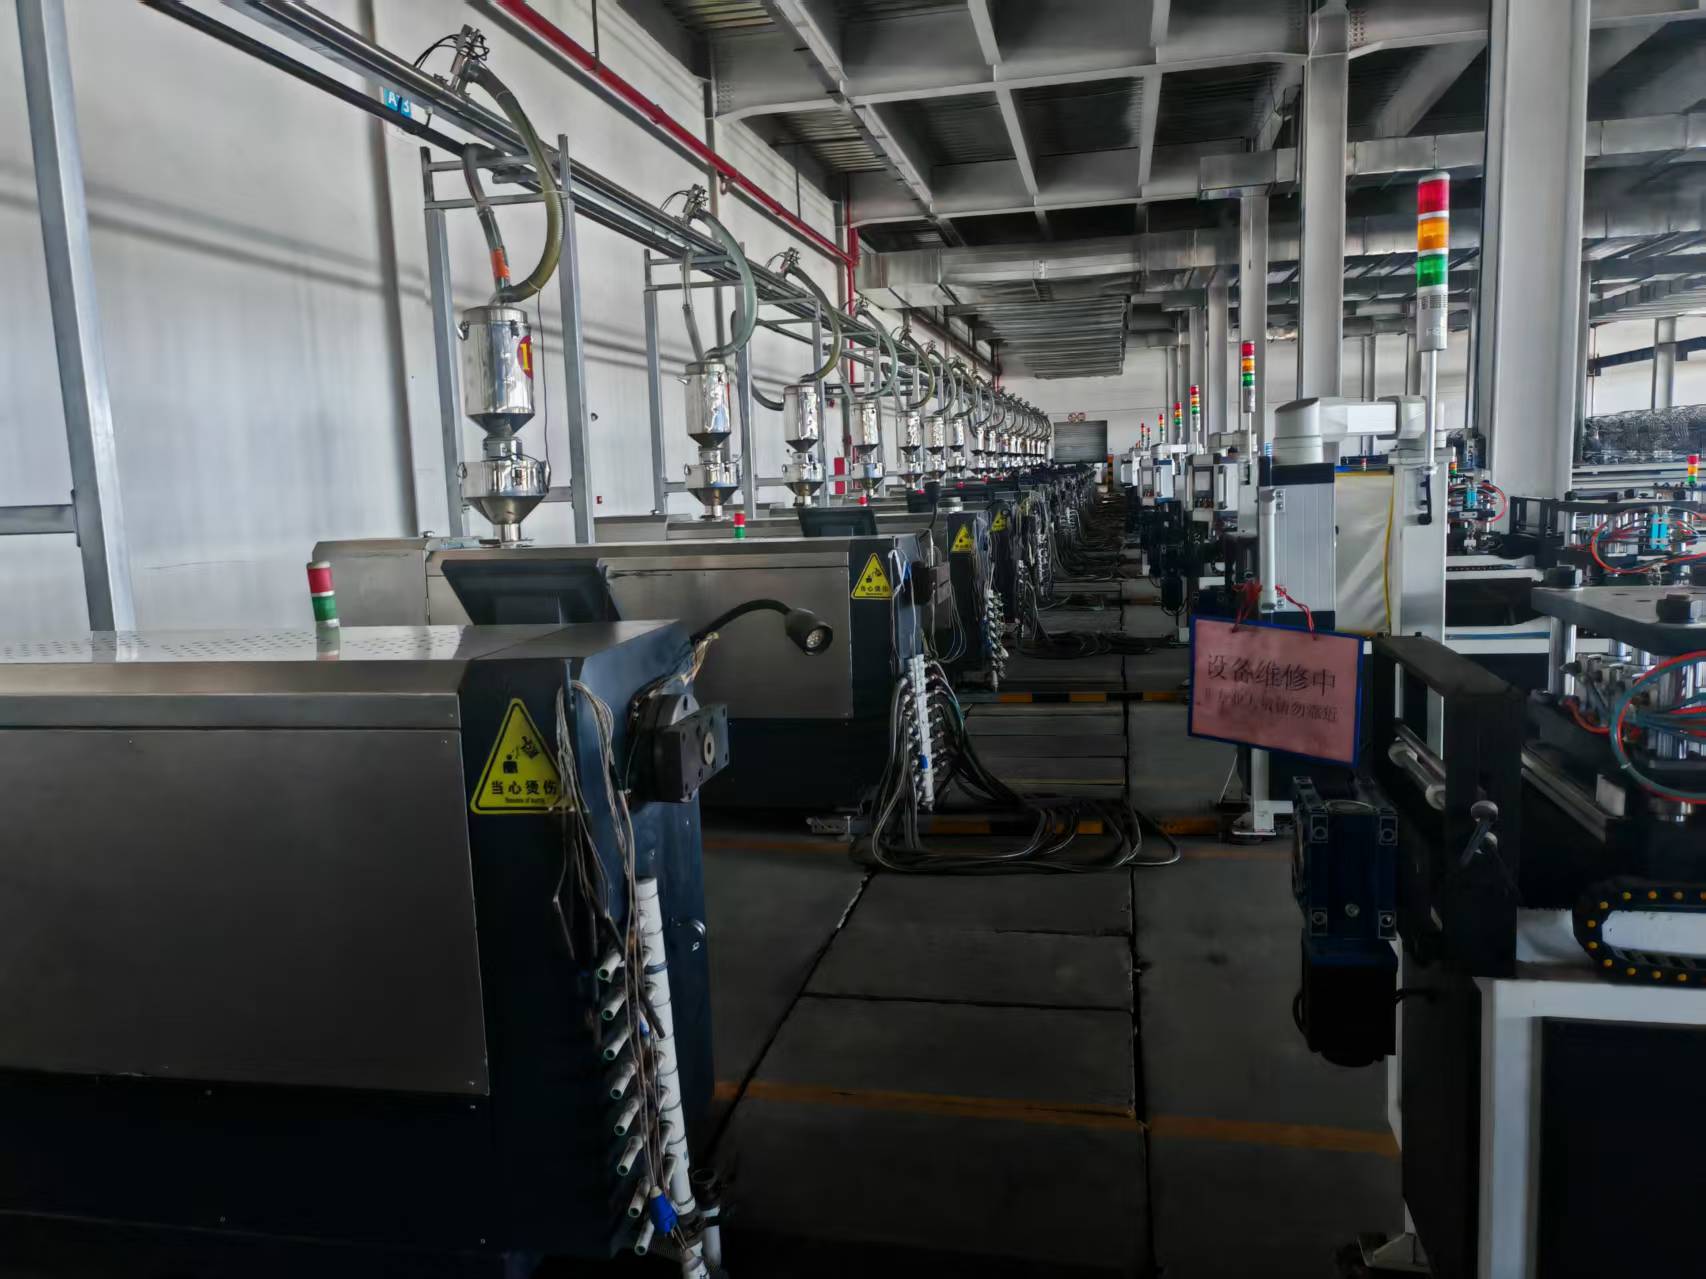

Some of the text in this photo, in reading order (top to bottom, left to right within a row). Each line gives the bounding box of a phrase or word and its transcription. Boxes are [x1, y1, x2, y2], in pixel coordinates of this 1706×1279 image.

[1208, 655, 1336, 696] 设备维修中
[491, 780, 557, 795] 当心烫伤
